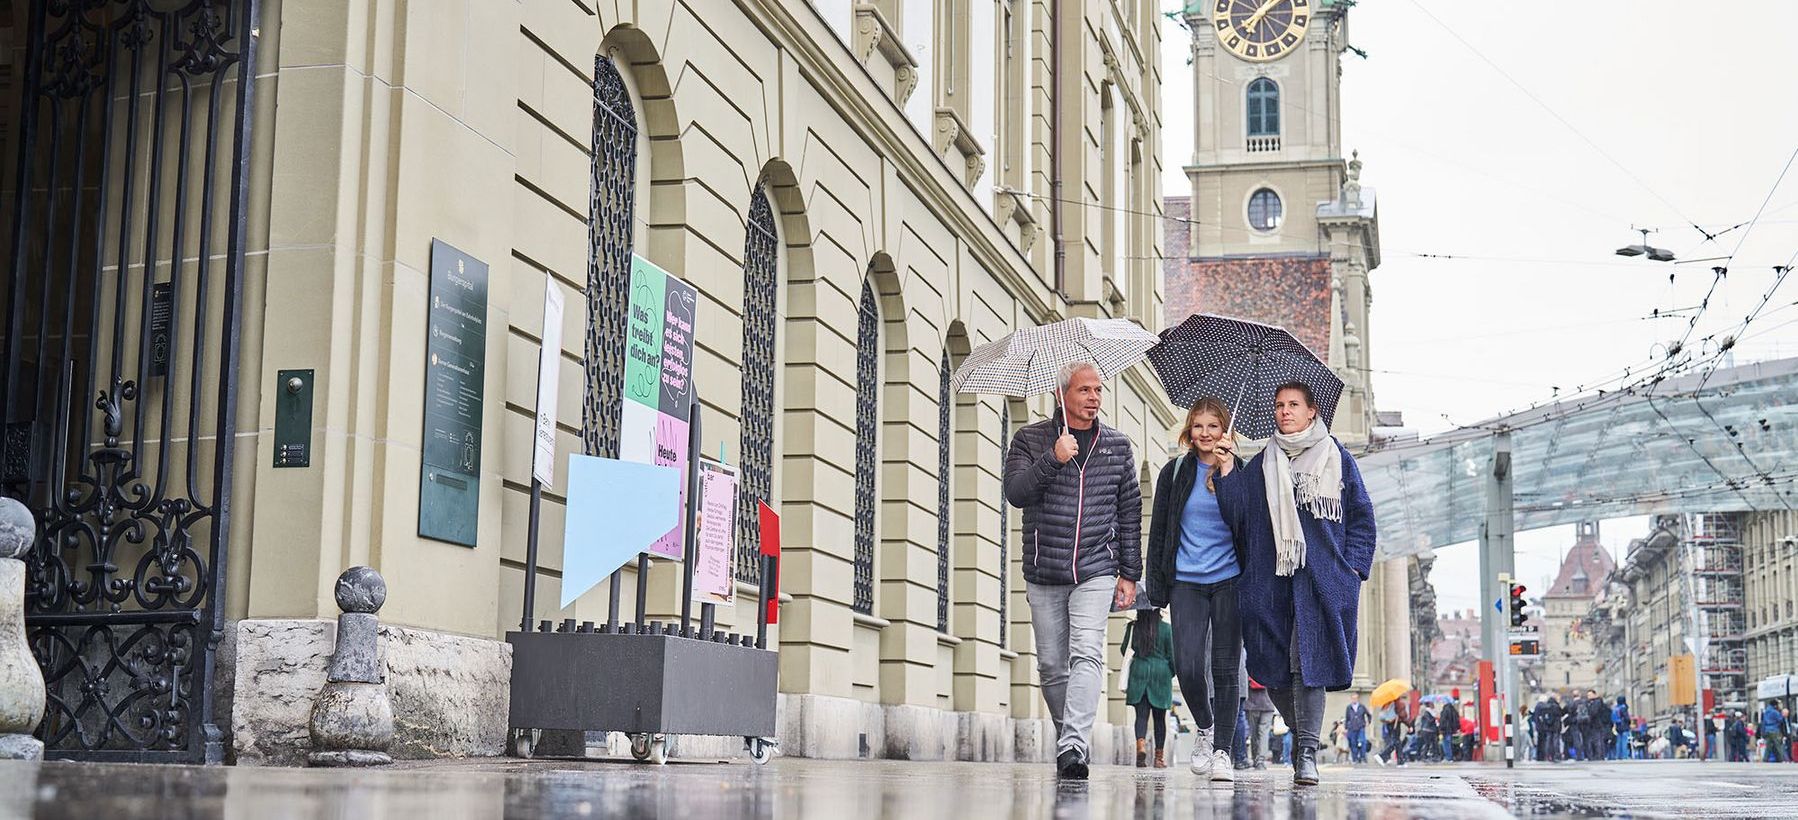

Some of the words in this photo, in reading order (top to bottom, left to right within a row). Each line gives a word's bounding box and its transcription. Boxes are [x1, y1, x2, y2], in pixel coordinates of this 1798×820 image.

[633, 303, 649, 324] Was
[666, 309, 678, 326] Wer
[678, 316, 691, 334] kann
[631, 323, 653, 347] treibt
[665, 327, 673, 339] es
[672, 329, 685, 345] sich
[630, 343, 647, 364] dich
[646, 351, 660, 370] an?
[663, 357, 688, 378] erfolglos
[661, 372, 670, 385] zu
[669, 374, 685, 391] sein?
[658, 443, 677, 463] Heute
